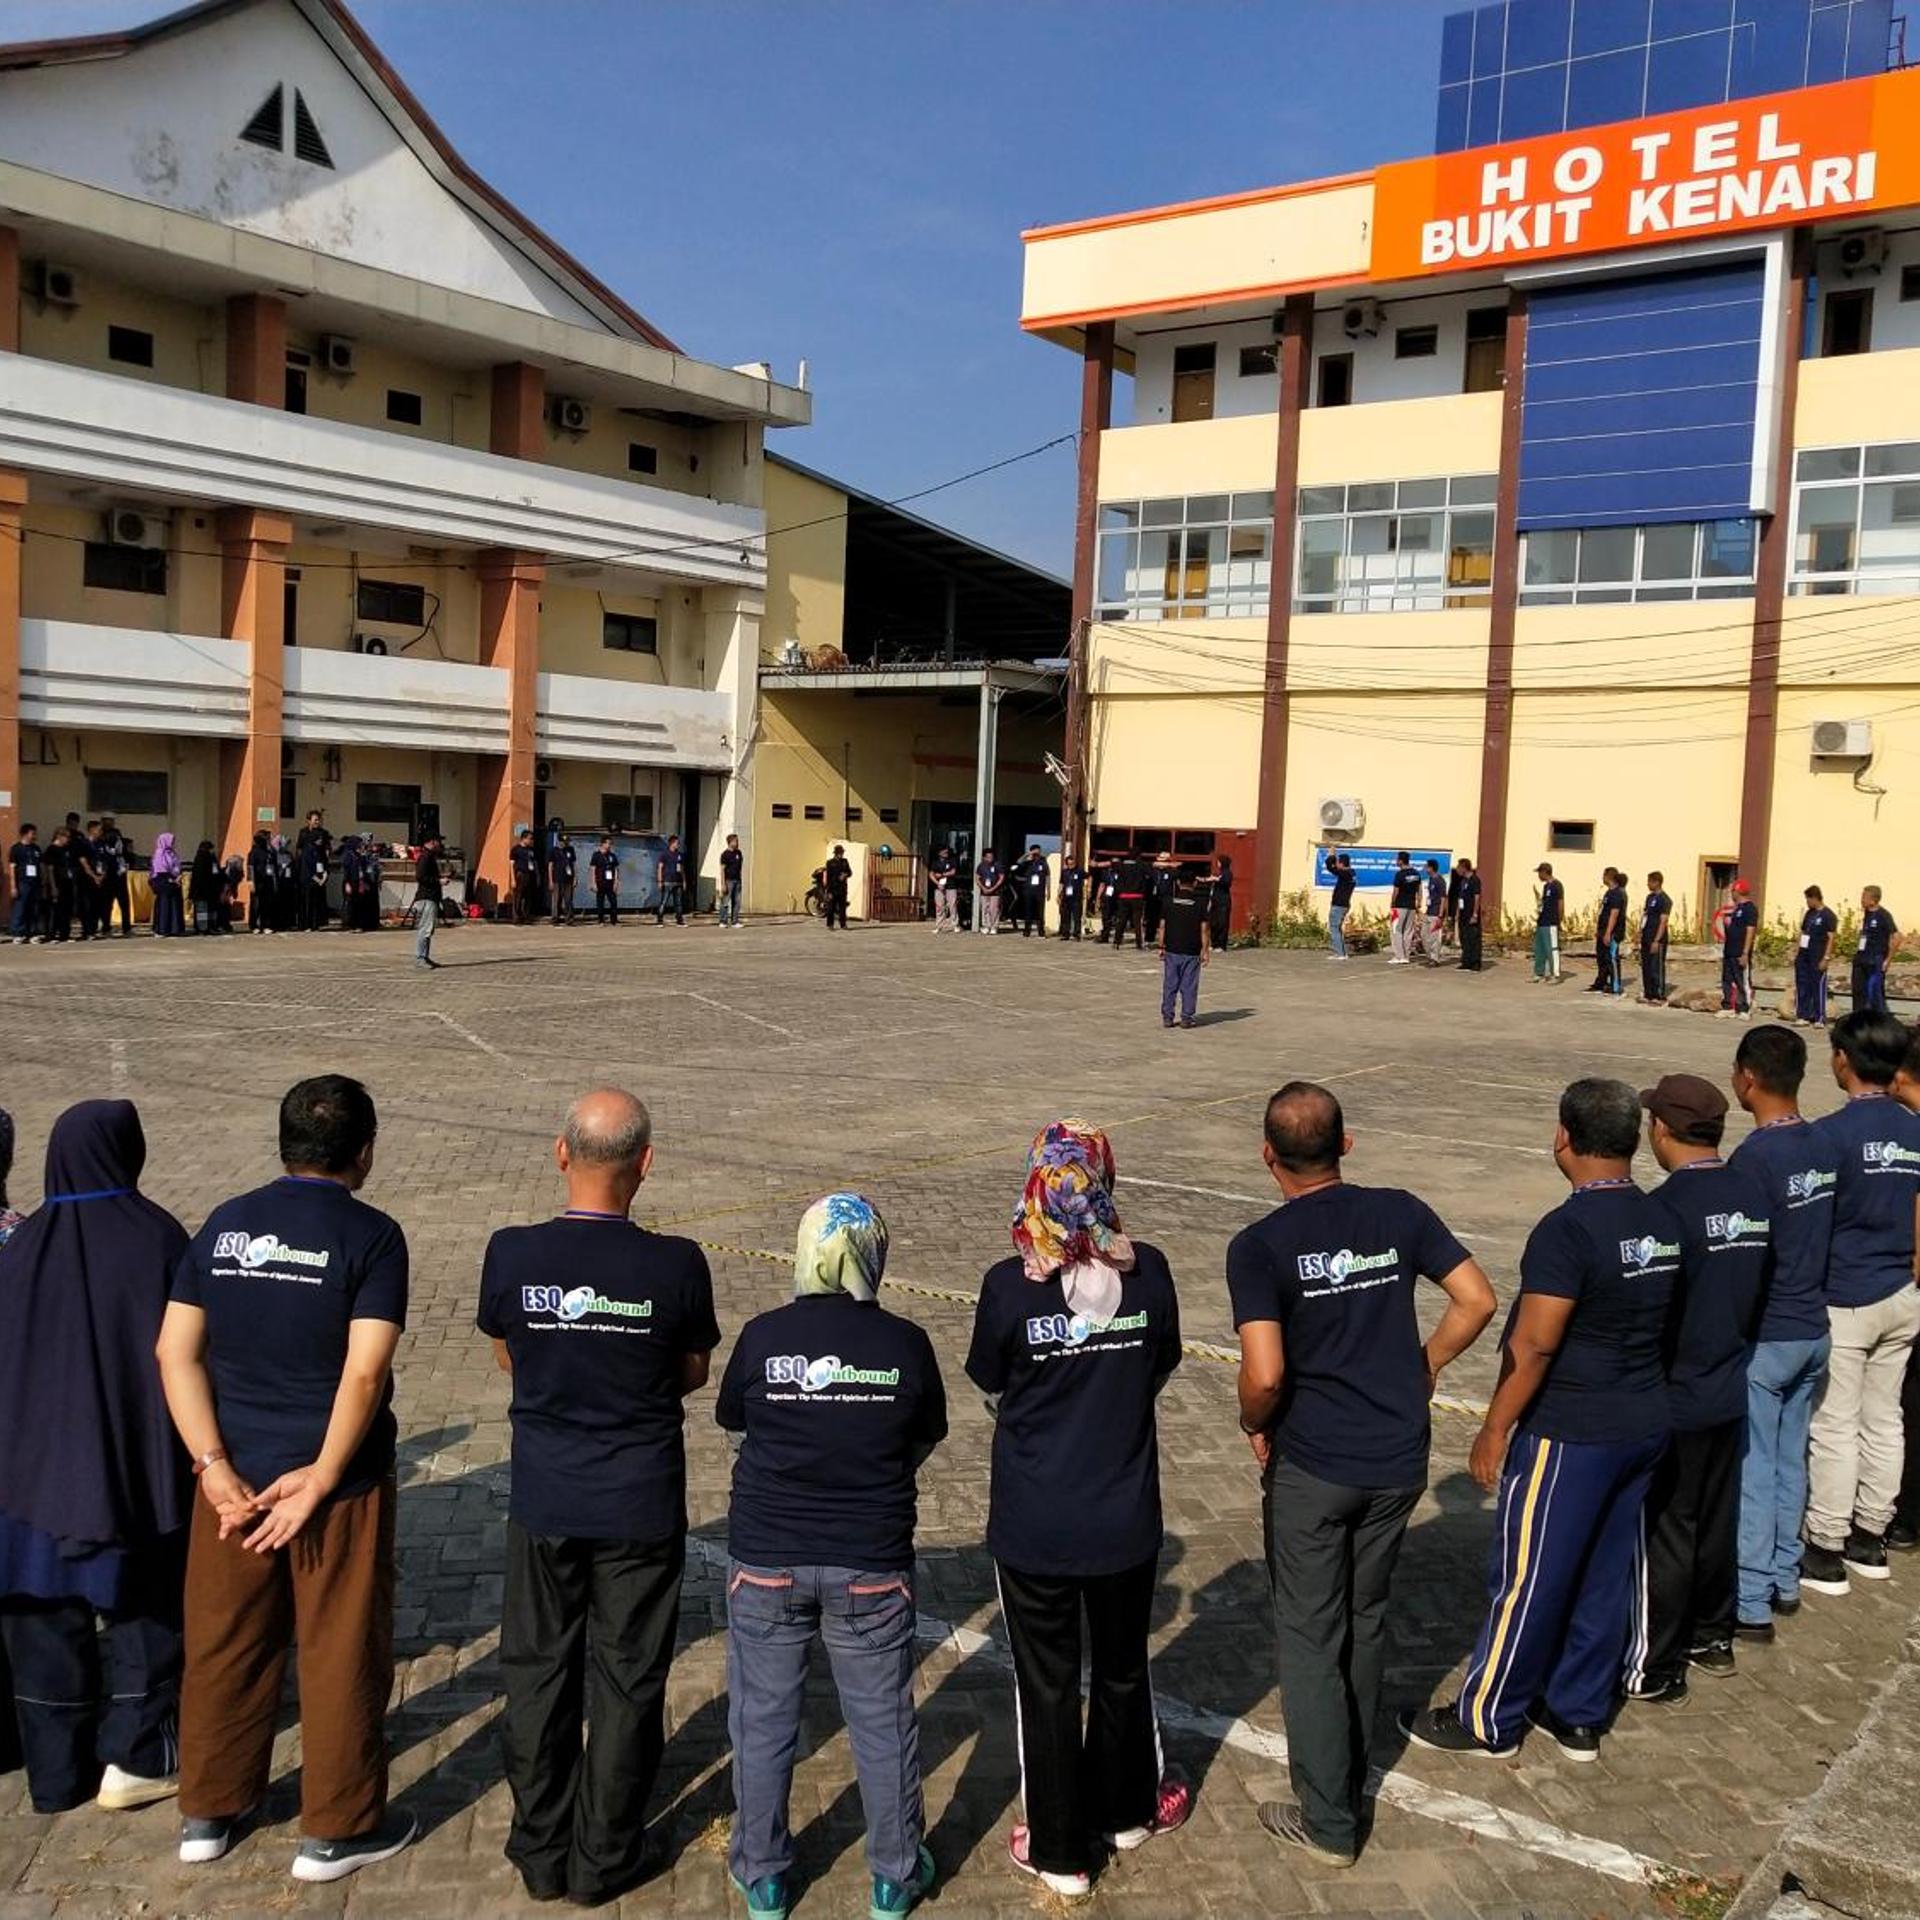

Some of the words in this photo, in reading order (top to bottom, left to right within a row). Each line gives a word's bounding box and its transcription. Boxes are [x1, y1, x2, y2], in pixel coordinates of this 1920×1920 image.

[1481, 113, 1800, 205] HOTEL
[1421, 197, 1592, 265] BUKIT
[1627, 151, 1877, 235] KENARI
[213, 1232, 251, 1261] ESQ
[1298, 1252, 1331, 1280] ESQ
[522, 1285, 562, 1314] ESQ
[1026, 1313, 1069, 1345] ESQ
[765, 1355, 807, 1385] ESQ
